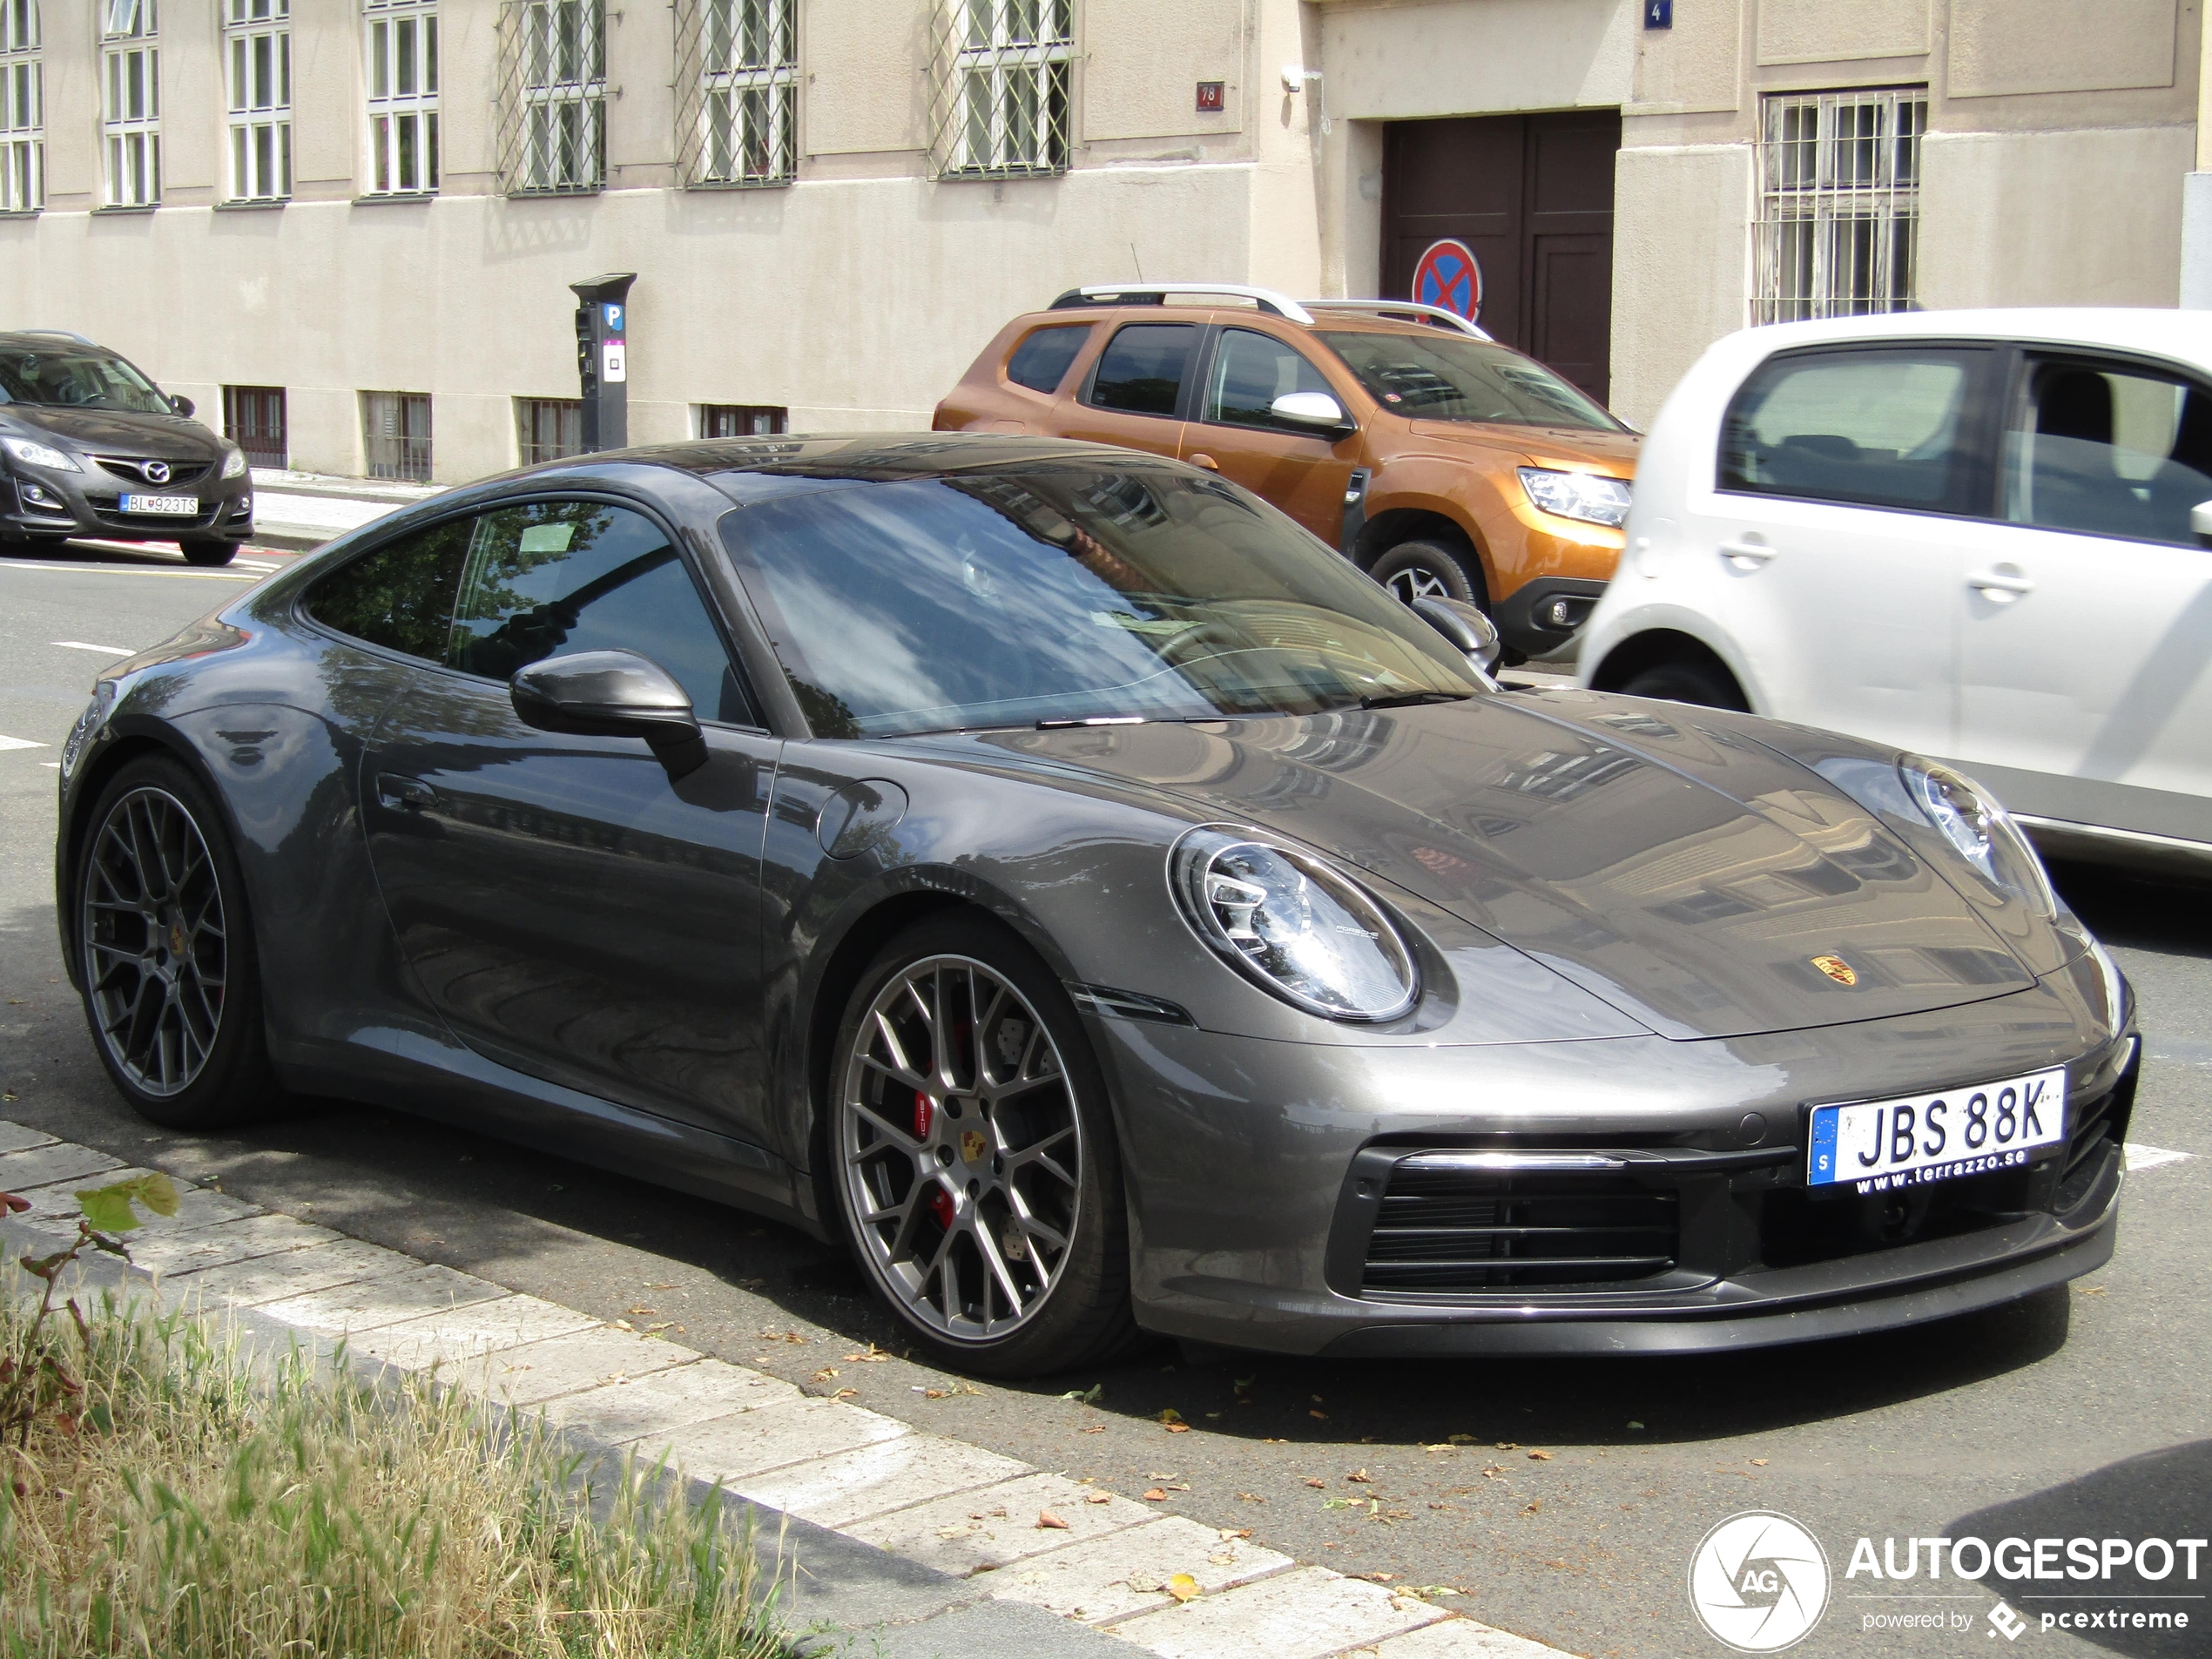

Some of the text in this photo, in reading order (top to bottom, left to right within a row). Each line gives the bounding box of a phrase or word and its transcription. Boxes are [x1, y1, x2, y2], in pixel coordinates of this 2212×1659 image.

[1651, 3, 1661, 21] 4
[1202, 87, 1215, 101] 78
[608, 306, 621, 327] P
[130, 496, 197, 513] BL 923TS
[1336, 925, 1379, 937] PORSCHE
[1858, 1080, 2046, 1168] JBS 88K
[1817, 1154, 1829, 1170] S
[1856, 1149, 2026, 1194] www.terrazzo.se
